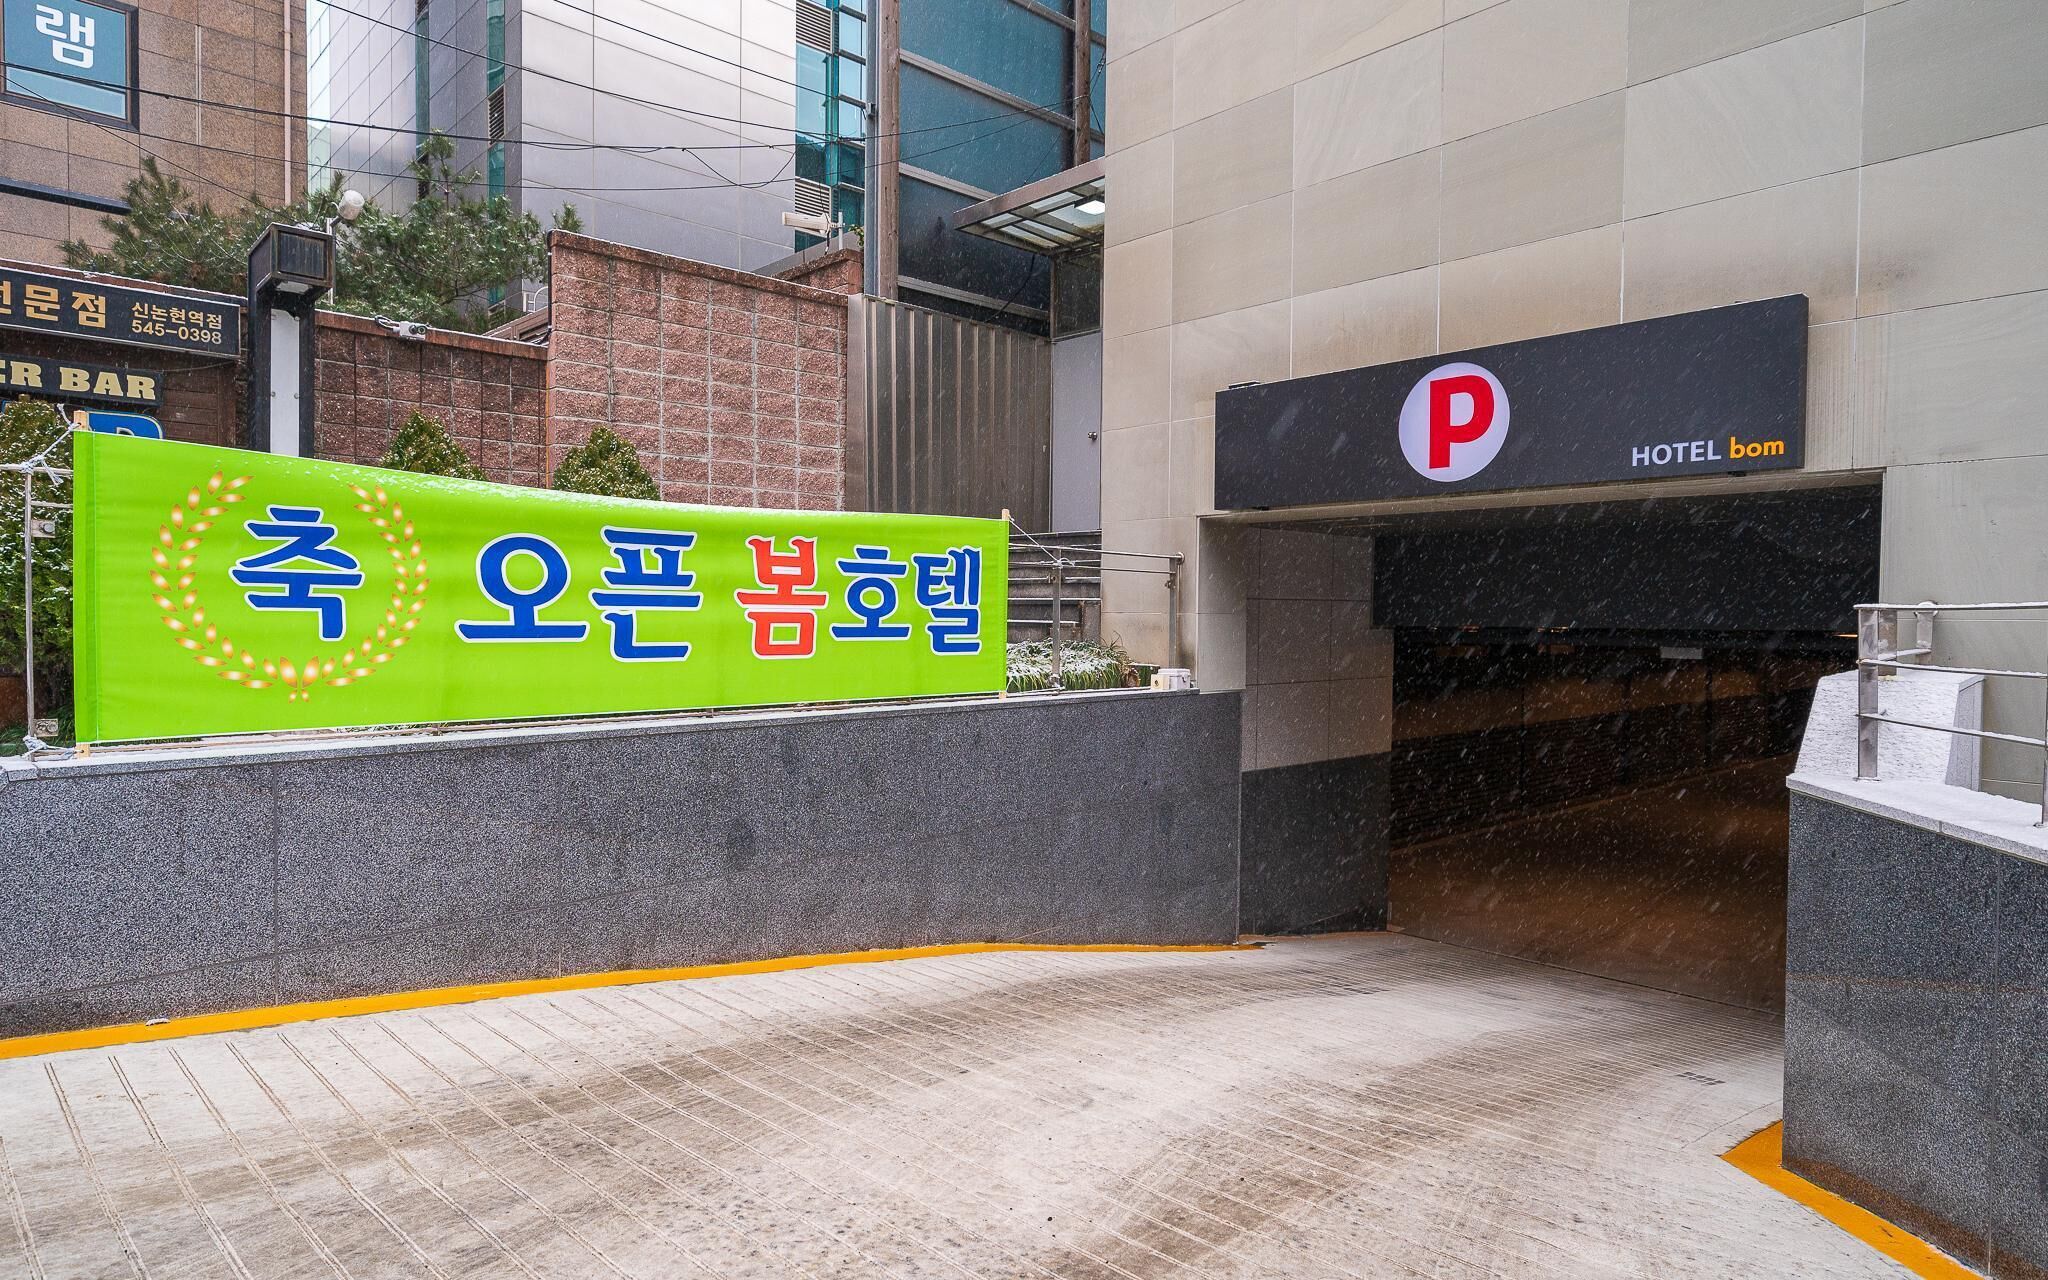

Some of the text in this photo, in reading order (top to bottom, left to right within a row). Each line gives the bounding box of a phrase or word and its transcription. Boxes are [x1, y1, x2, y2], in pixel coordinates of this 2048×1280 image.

[35, 4, 96, 69] 램
[131, 302, 222, 330] 신논현역점
[131, 319, 222, 345] 545-0398
[0, 359, 156, 400] R BAR
[1429, 374, 1495, 470] P
[1632, 436, 1785, 467] HOTEL bom
[229, 504, 983, 663] 축 오픈 봄호텔
